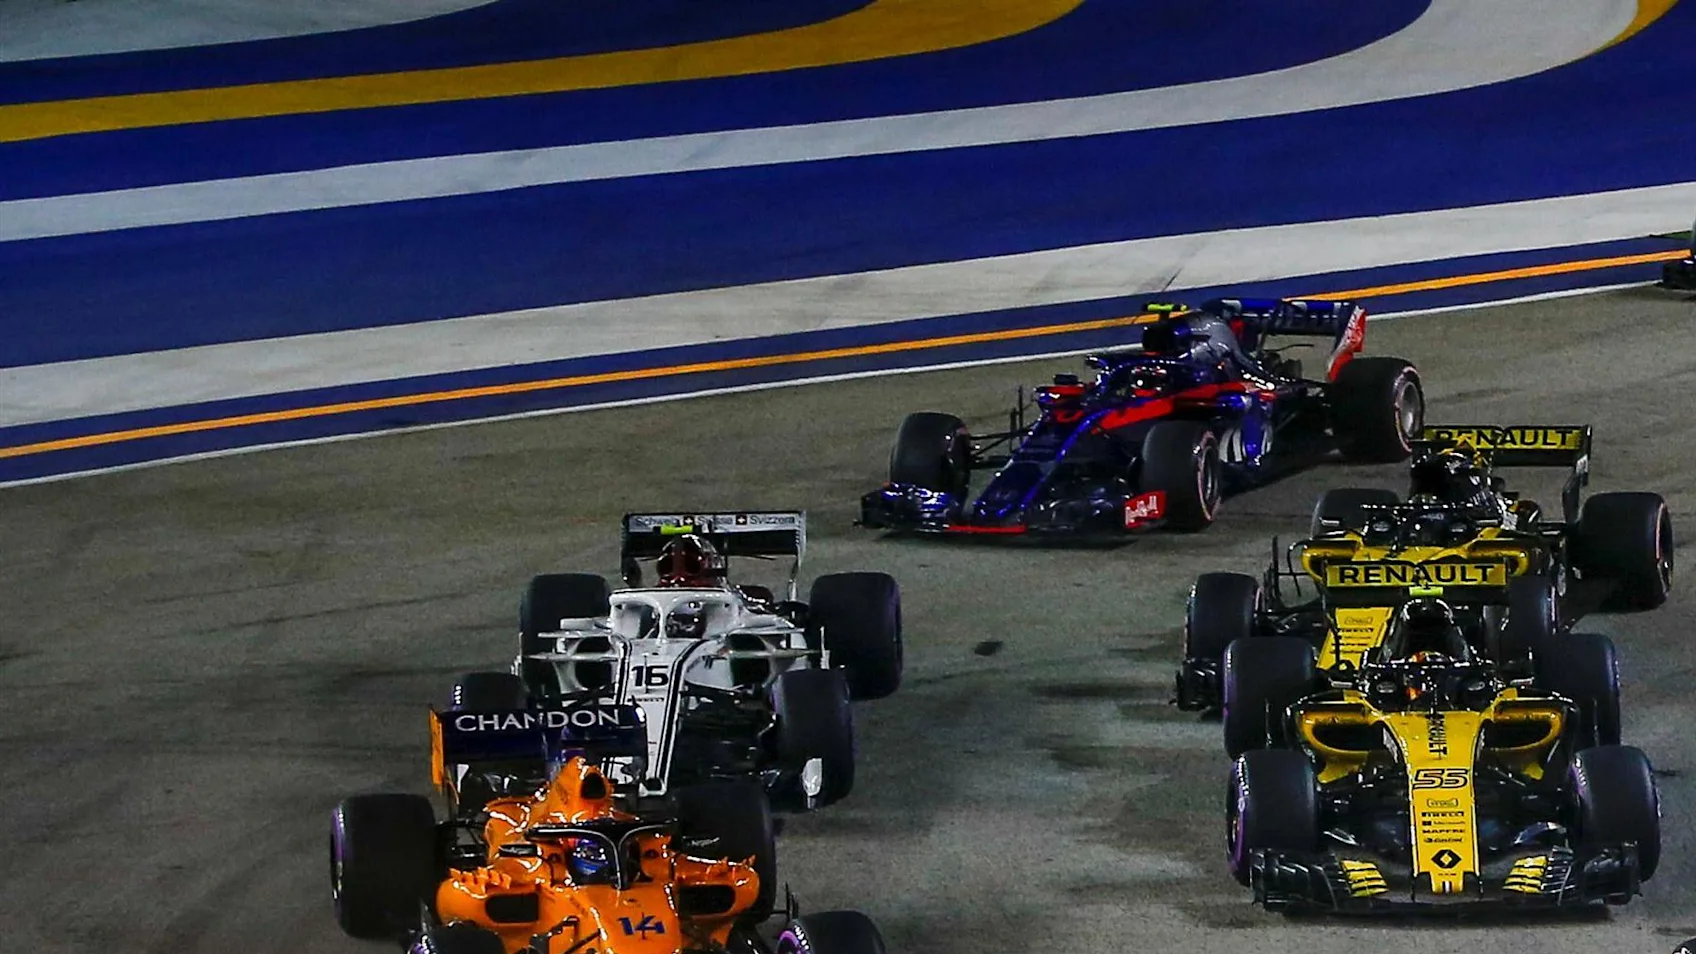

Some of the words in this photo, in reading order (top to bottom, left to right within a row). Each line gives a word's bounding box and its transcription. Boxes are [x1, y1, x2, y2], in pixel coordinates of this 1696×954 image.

[1338, 565, 1491, 584] RENAULT
[631, 665, 669, 688] 16
[455, 708, 620, 732] CHANDON
[1413, 768, 1469, 790] 55
[616, 914, 665, 936] 14
